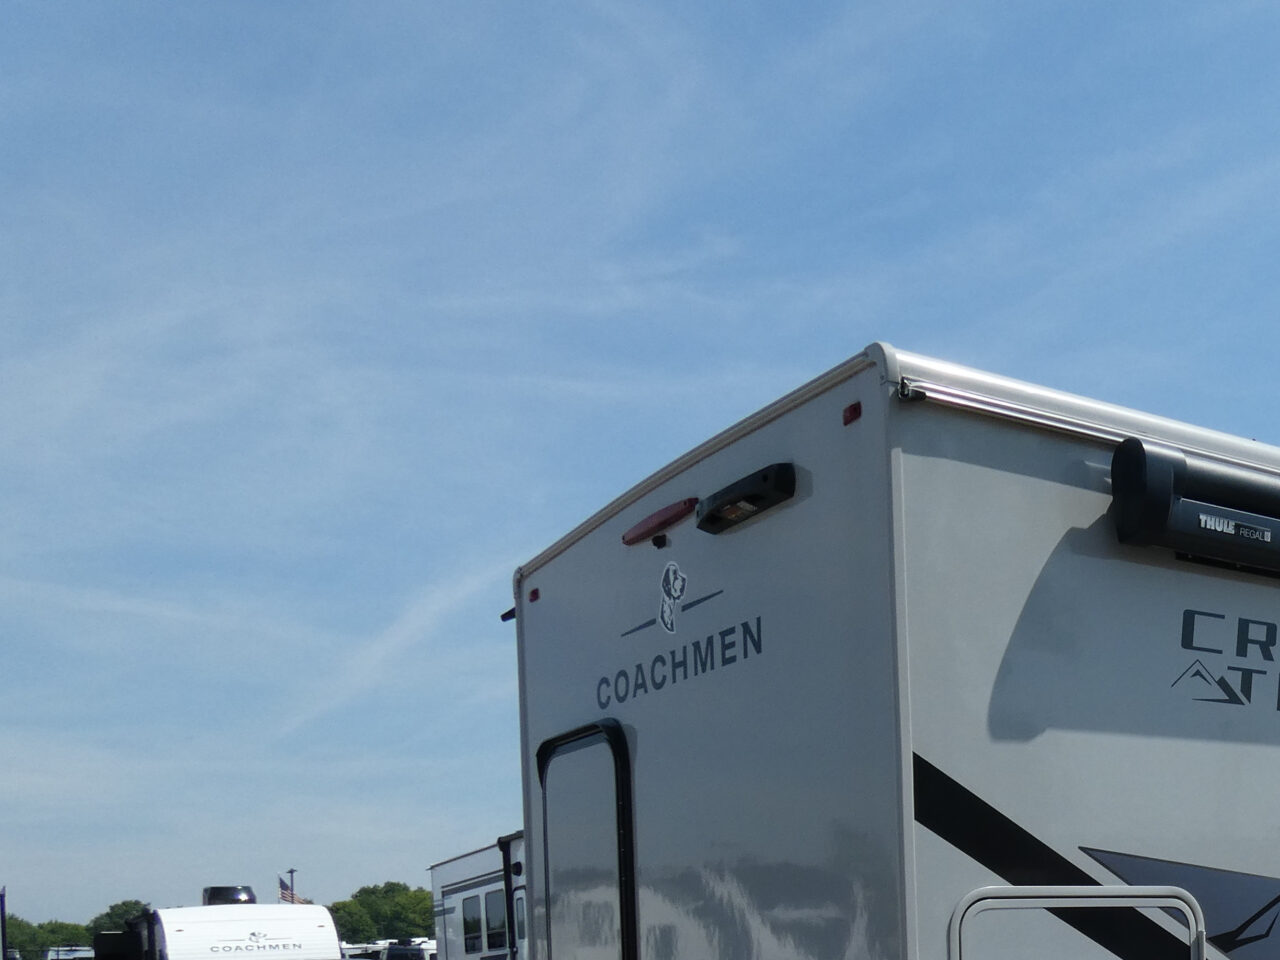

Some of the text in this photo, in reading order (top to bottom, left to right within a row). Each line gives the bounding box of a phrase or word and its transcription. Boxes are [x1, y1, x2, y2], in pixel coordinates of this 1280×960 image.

[1199, 513, 1236, 535] THULE
[1240, 527, 1266, 541] REGAL
[597, 616, 762, 710] COACHMEN
[210, 943, 302, 952] COACHMEN
